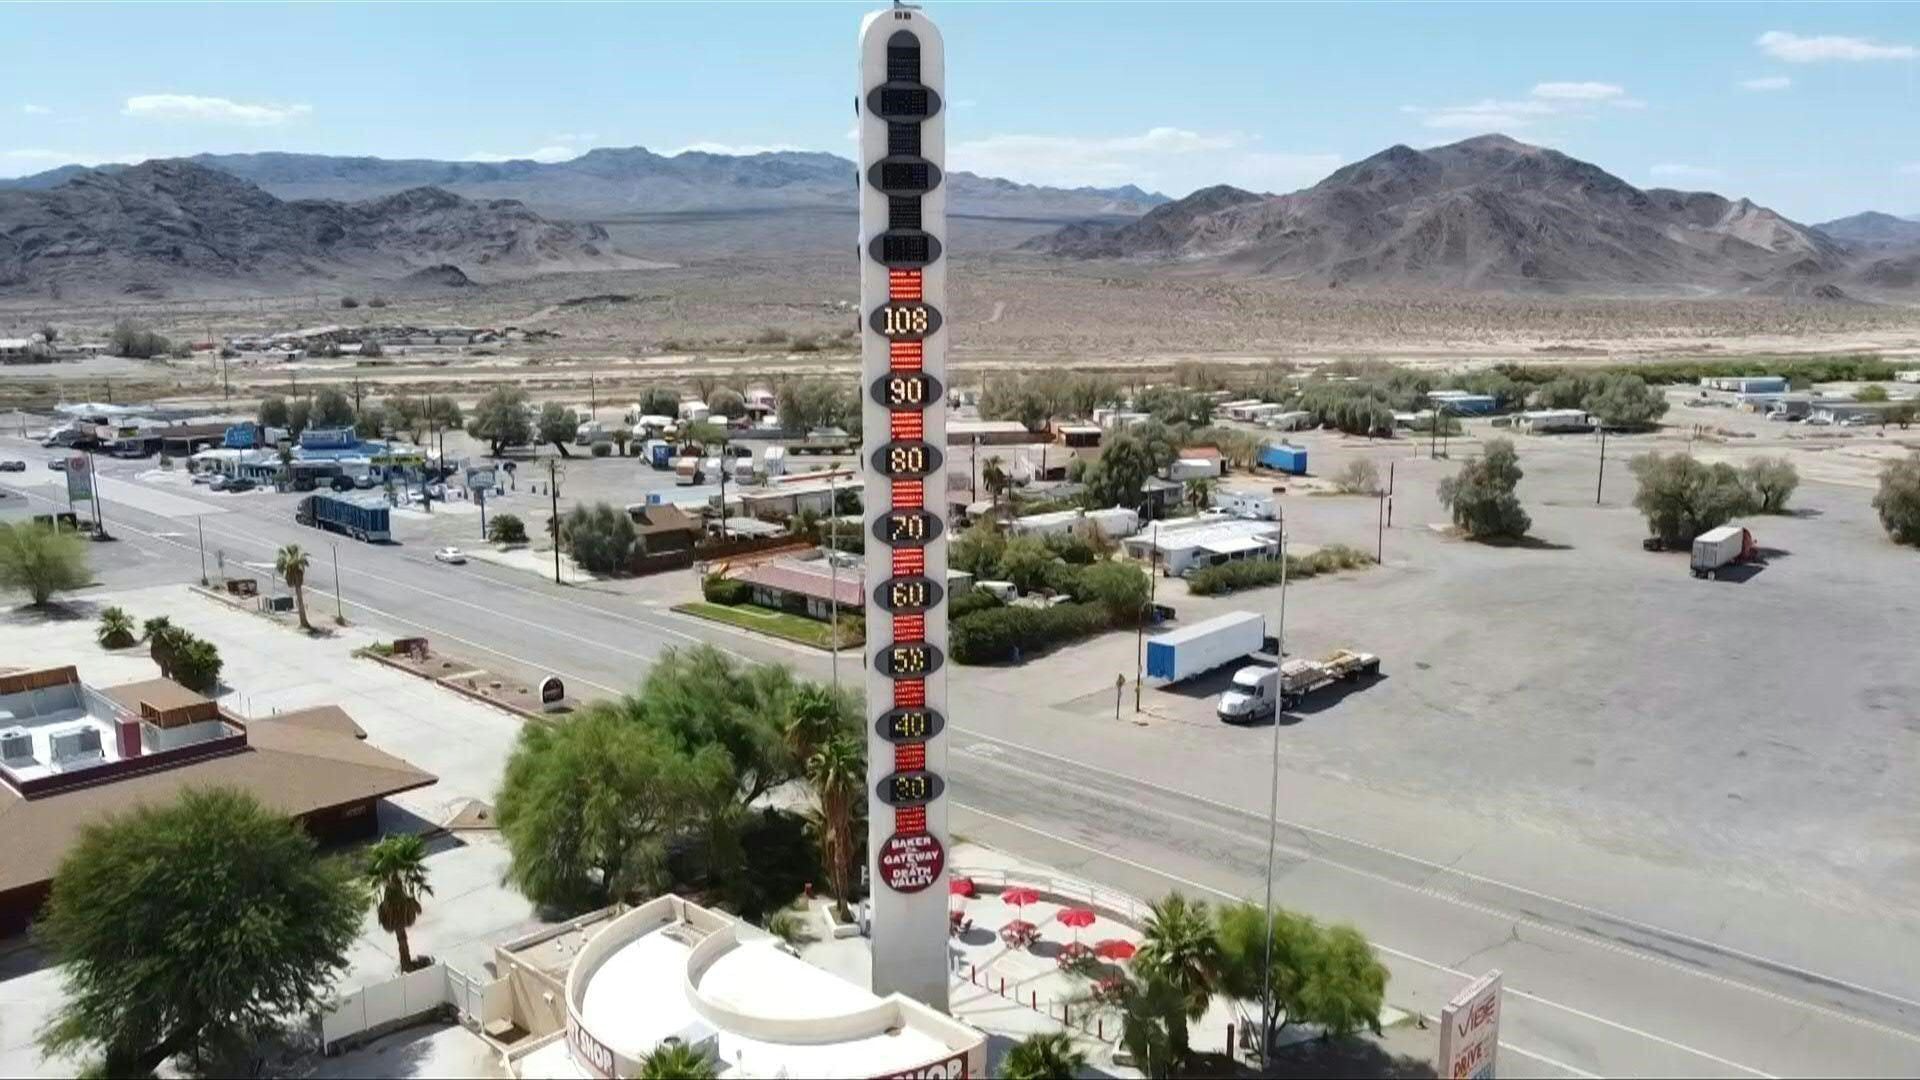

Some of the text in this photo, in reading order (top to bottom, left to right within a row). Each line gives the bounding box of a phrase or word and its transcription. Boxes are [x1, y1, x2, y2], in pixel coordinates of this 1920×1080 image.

[884, 307, 927, 334] 108
[890, 378, 922, 403] 90
[891, 447, 922, 472] 80
[892, 514, 923, 540] 70
[893, 582, 923, 607] 60
[895, 713, 924, 736] 40
[891, 837, 931, 849] BAKER
[883, 850, 939, 865] GATEWAY
[891, 875, 933, 888] VALLEY
[893, 866, 931, 878] DEATH
[580, 1028, 613, 1072] SHOP
